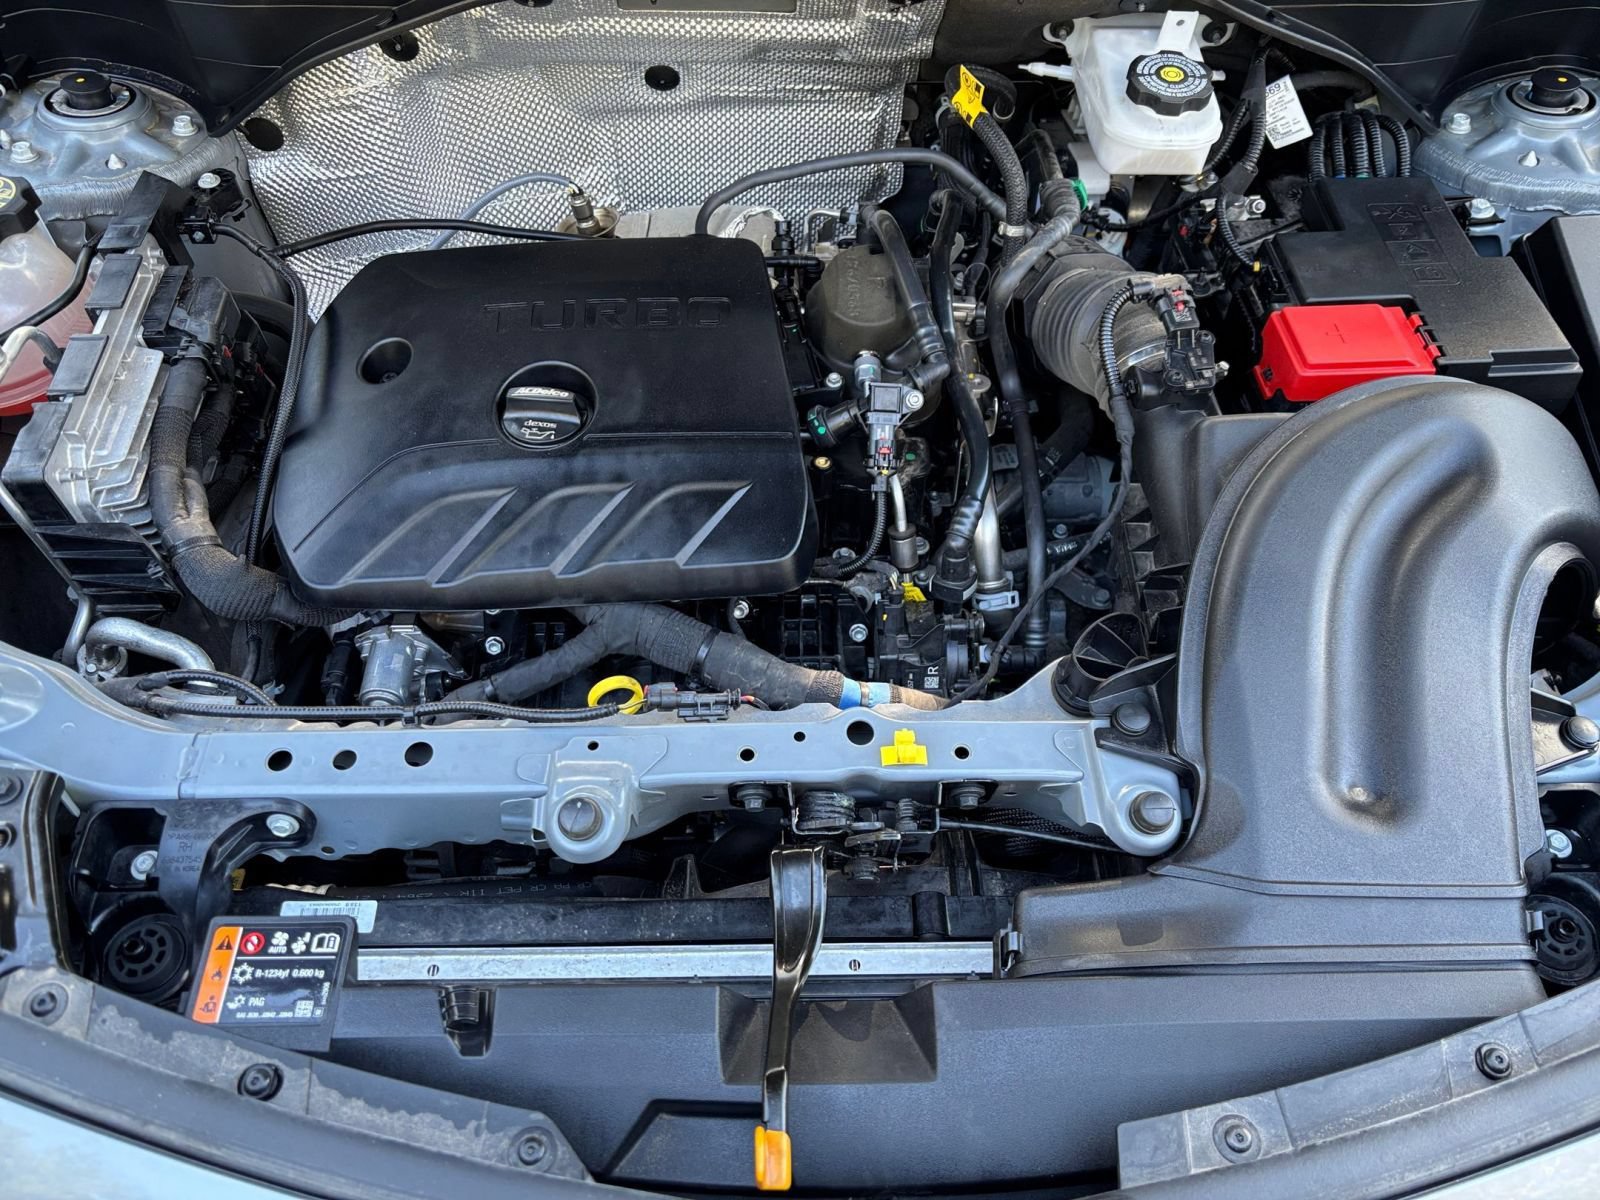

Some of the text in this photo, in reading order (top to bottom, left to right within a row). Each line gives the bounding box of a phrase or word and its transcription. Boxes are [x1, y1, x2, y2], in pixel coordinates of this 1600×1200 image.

[482, 296, 732, 334] TURBO
[513, 387, 569, 398] ACDelco
[524, 420, 557, 429] dexos
[927, 666, 939, 675] R
[178, 841, 193, 852] RH
[267, 946, 288, 954] AUTO
[315, 968, 325, 979] kg
[248, 997, 266, 1007] PAG
